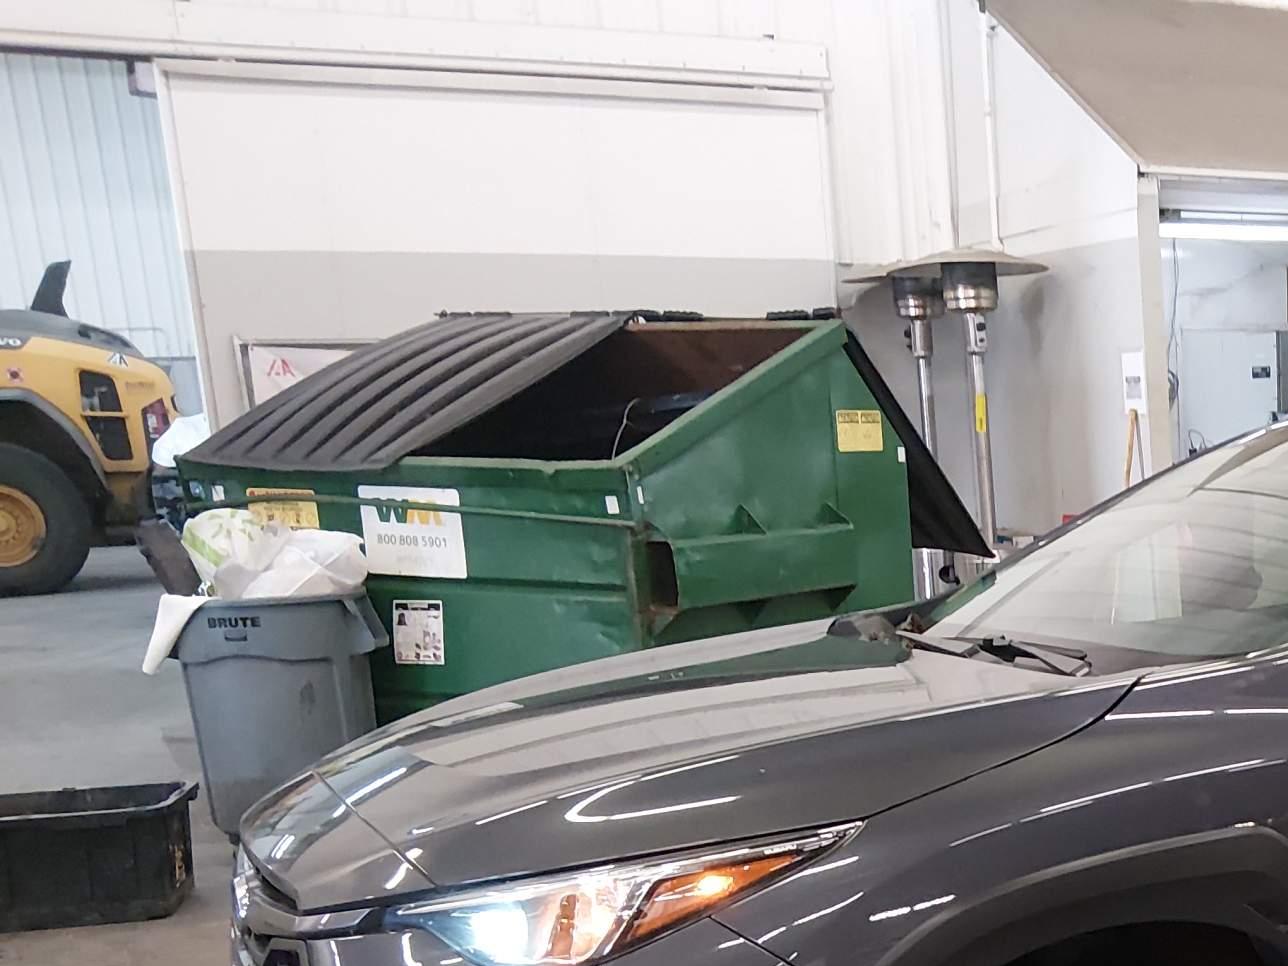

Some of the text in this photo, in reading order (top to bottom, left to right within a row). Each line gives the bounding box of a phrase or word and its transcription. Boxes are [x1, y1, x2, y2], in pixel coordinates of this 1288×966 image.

[377, 533, 448, 548] 800 808 5901
[207, 616, 261, 629] BRUTE
